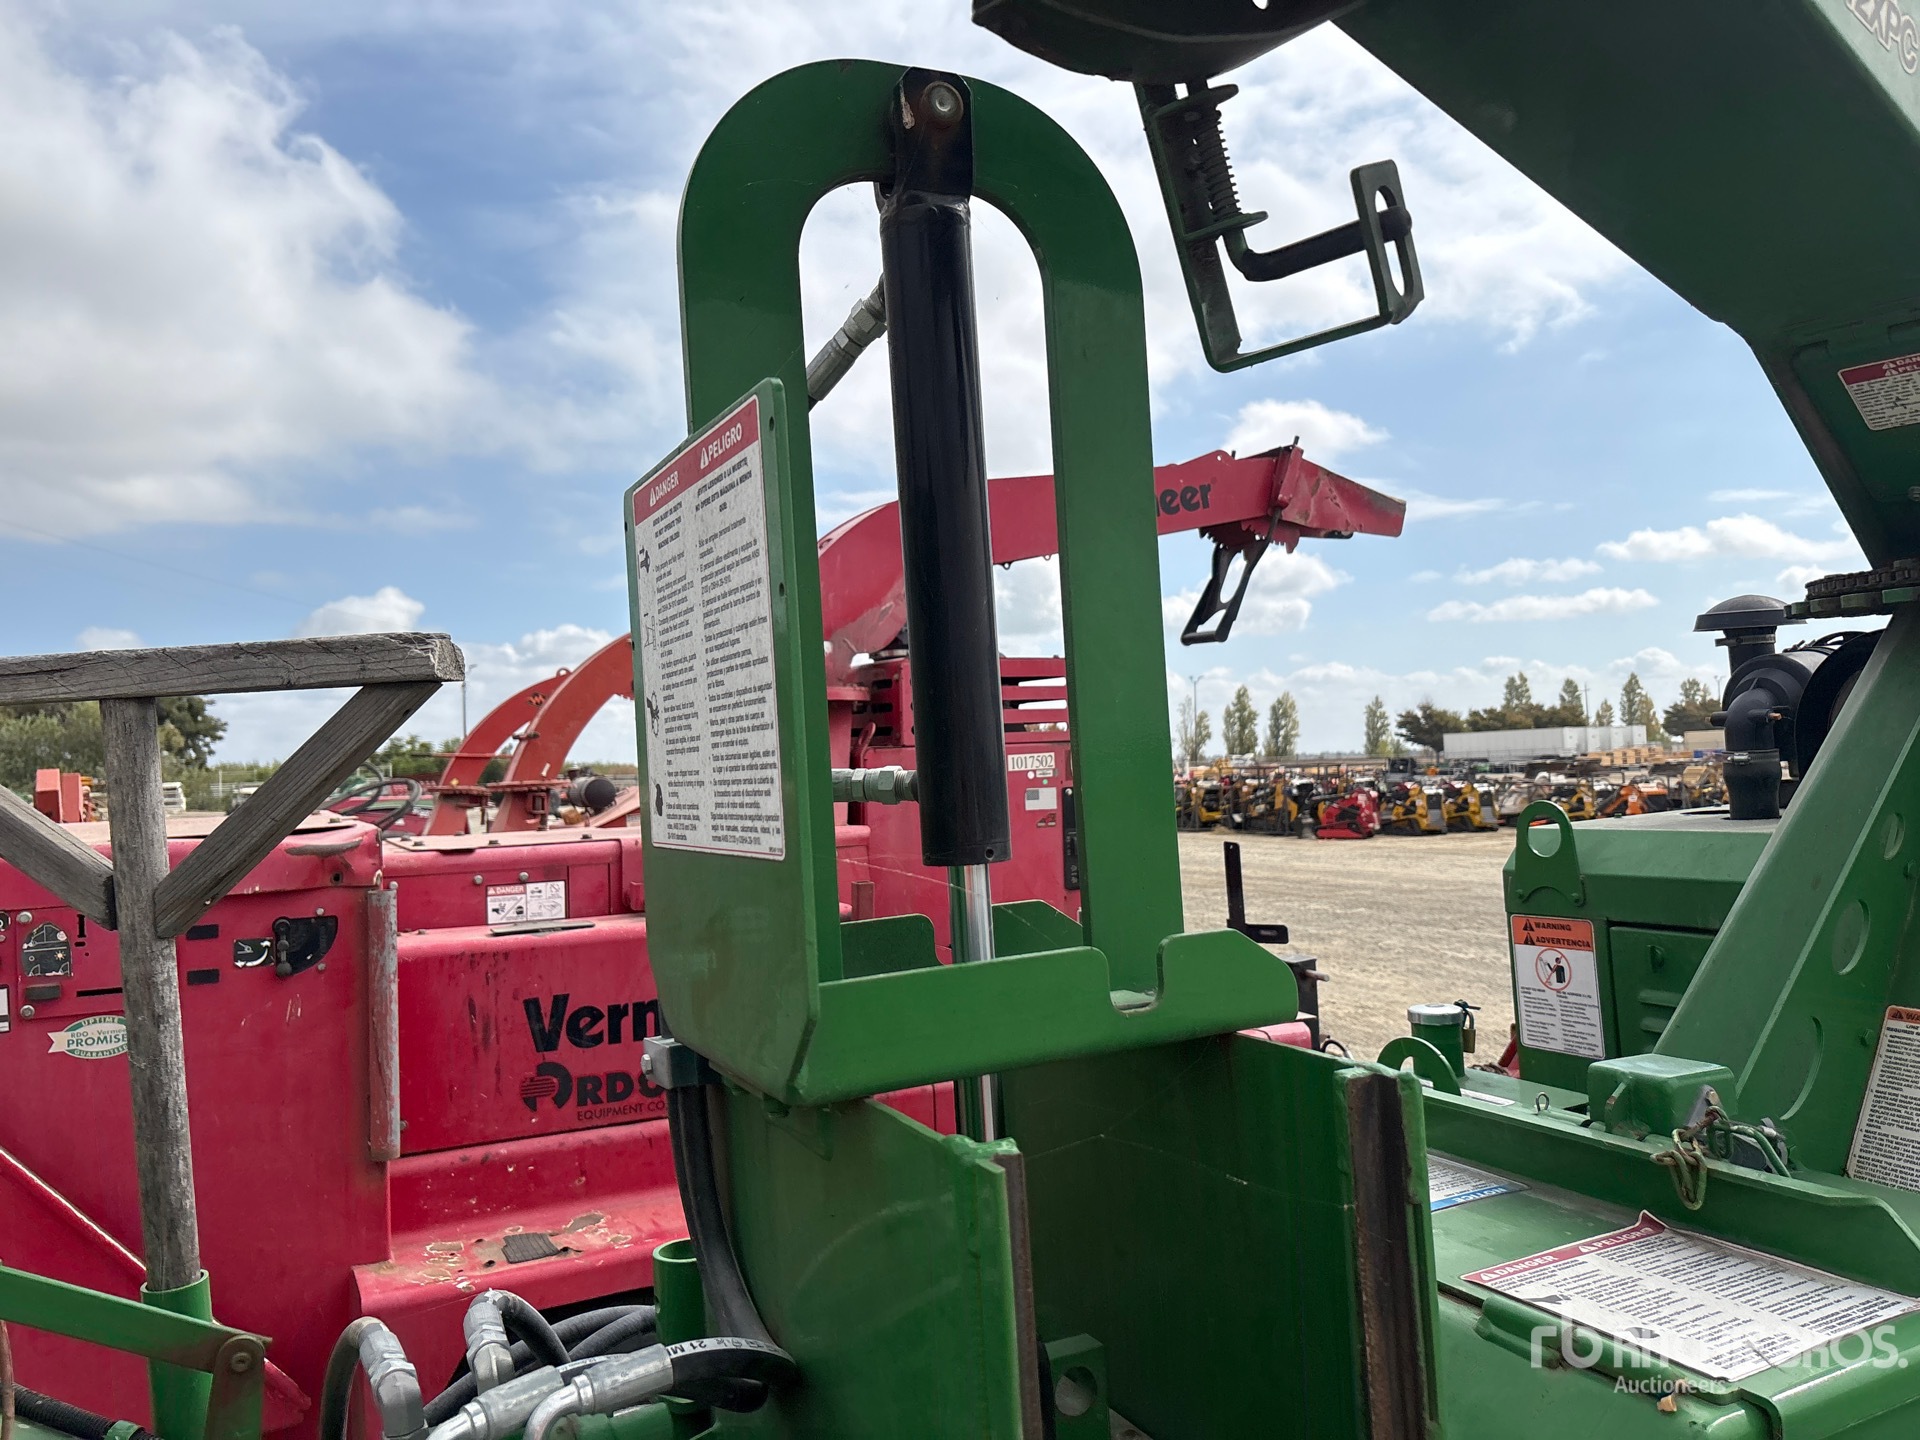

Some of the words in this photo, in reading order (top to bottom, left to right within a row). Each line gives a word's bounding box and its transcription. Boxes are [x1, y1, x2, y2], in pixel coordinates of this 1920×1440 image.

[1898, 364, 1920, 373] PEL
[708, 423, 742, 459] PELIGRO
[655, 471, 679, 501] DANGER
[1156, 484, 1212, 517] eer
[1011, 755, 1053, 769] 1017502
[496, 886, 524, 894] DANGER
[1534, 922, 1572, 931] WARNING
[1536, 936, 1591, 948] ADVERTENCIA
[82, 1017, 117, 1026] UPTIME
[67, 1033, 127, 1048] PROMISE
[577, 1103, 644, 1121] EQUIPMENT
[1451, 1186, 1508, 1203] NOTICE
[1494, 1255, 1559, 1277] DANGER
[690, 1340, 707, 1352] 21
